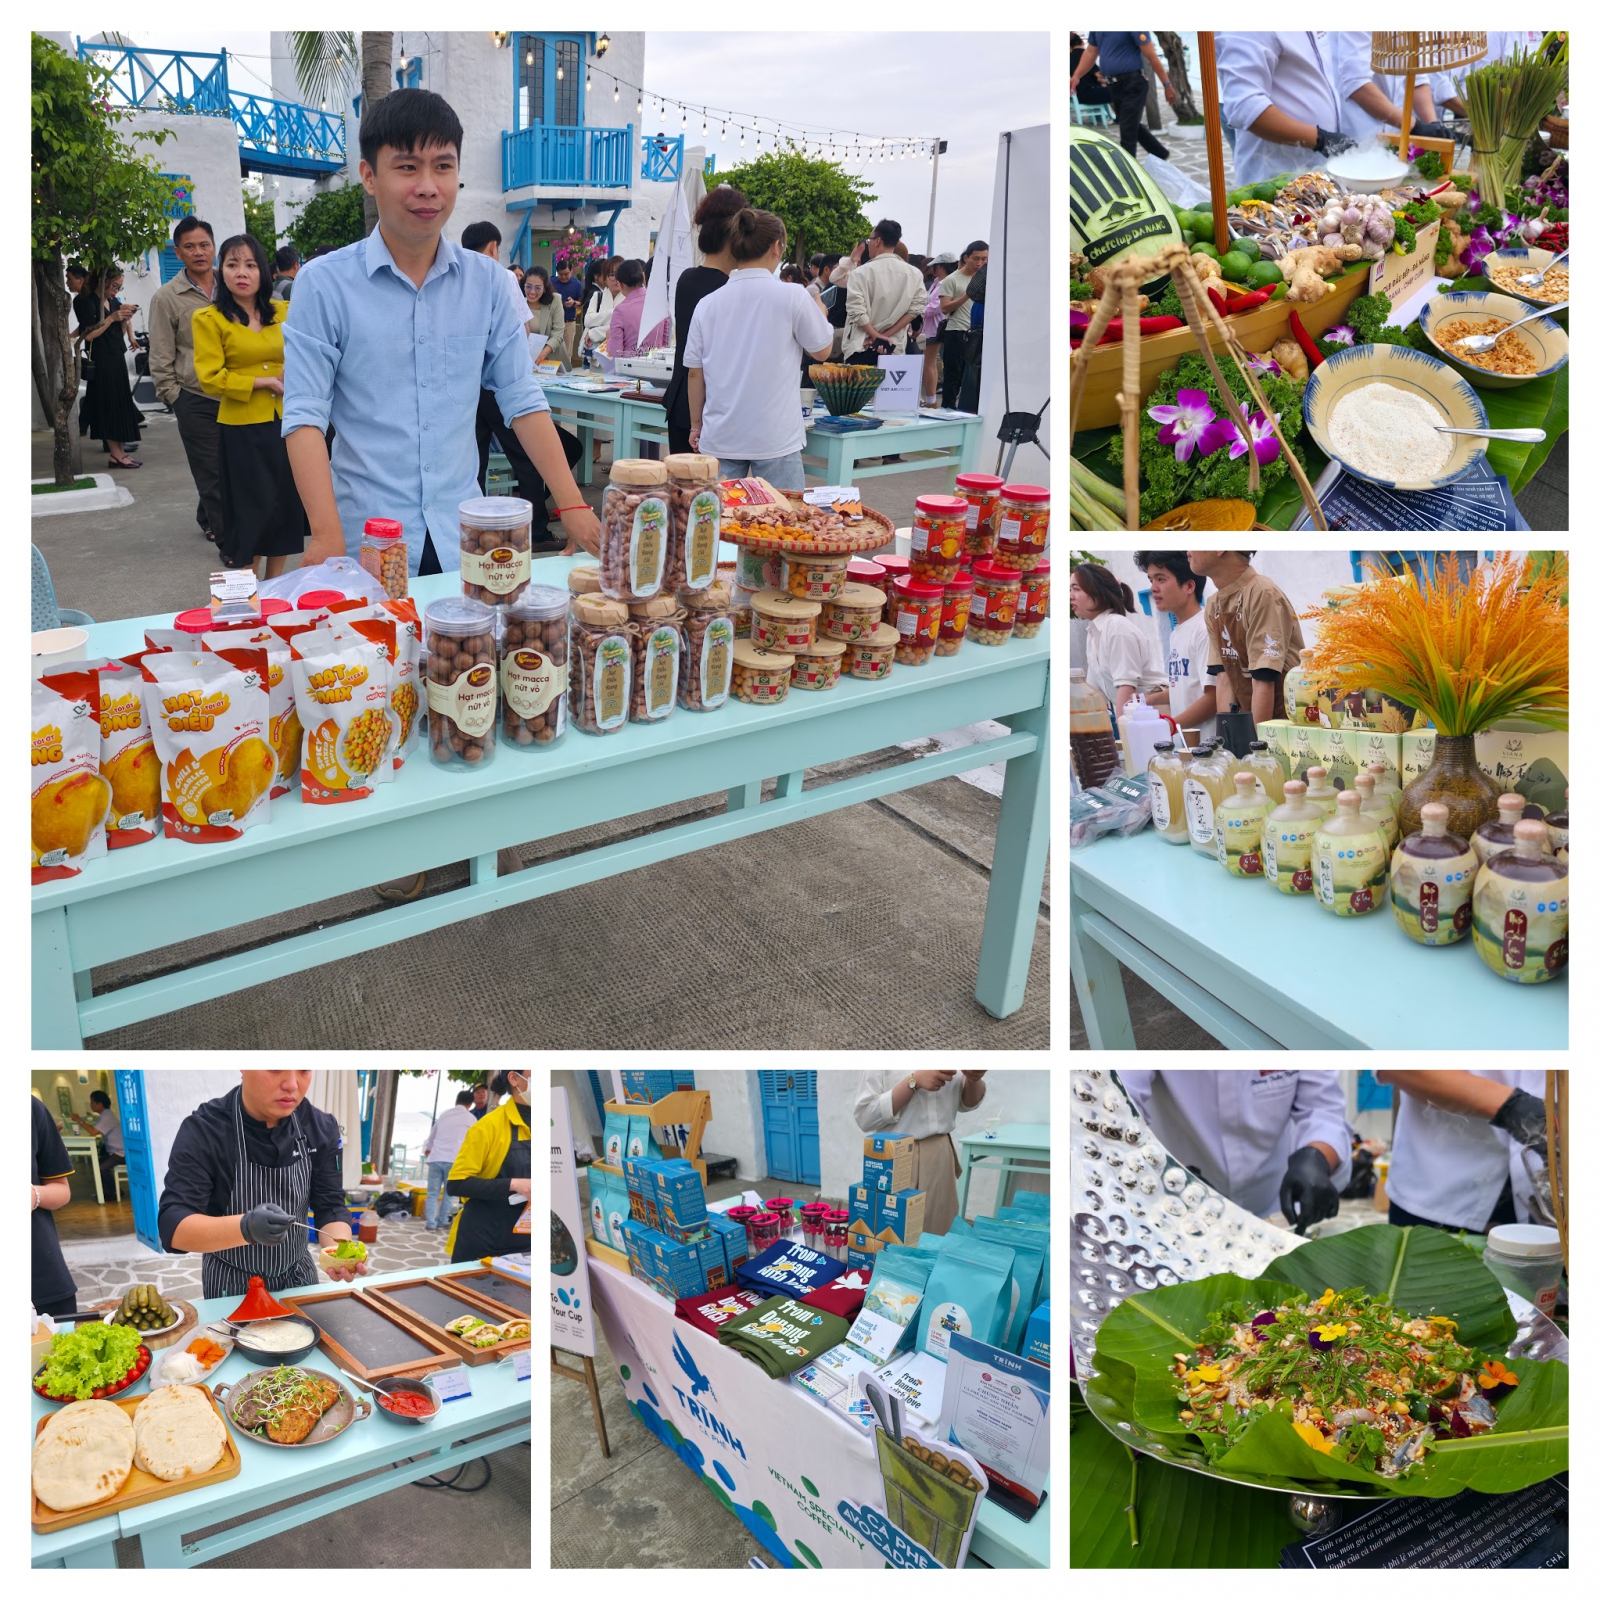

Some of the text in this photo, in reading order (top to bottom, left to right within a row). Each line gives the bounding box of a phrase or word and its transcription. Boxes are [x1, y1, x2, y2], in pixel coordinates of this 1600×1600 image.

[1132, 228, 1145, 239] DA
[478, 560, 523, 571] Hạt macca
[505, 570, 516, 580] vỏ
[308, 664, 346, 690] HẠT
[507, 670, 550, 684] Hạt macca
[316, 686, 353, 705] MIX
[458, 686, 495, 704] Hạt macca
[530, 684, 540, 693] vỏ
[162, 690, 204, 714] HẠT
[483, 698, 491, 708] vỏ
[100, 712, 142, 738] ỘNG
[168, 707, 214, 732] ĐIỀU
[315, 738, 325, 770] SPICY
[175, 760, 200, 790] CHILI &
[181, 769, 206, 795] GARLIC
[187, 776, 210, 799] COATED
[788, 1244, 819, 1262] from
[758, 1266, 786, 1282] with
[784, 1277, 812, 1294] love
[551, 1293, 558, 1303] To
[552, 1306, 582, 1324] Your Cup
[778, 1300, 815, 1322] from
[738, 1324, 774, 1340] with
[759, 1310, 812, 1346] Danang
[772, 1335, 800, 1356] love
[904, 1396, 922, 1410] love
[768, 1466, 865, 1551] VIETNAM SPECIALTY
[796, 1501, 833, 1535] COFFEE
[1318, 1541, 1334, 1553] Sinh
[1344, 1531, 1352, 1540] từ
[1352, 1524, 1368, 1536] sông
[1368, 1516, 1382, 1528] nước
[1384, 1507, 1400, 1520] Nam
[1324, 1514, 1410, 1562] lớn, món gỏi cá trích mang
[1450, 1548, 1464, 1562] bình
[1464, 1544, 1471, 1554] dị
[1471, 1538, 1484, 1550] của
[1484, 1532, 1494, 1544] ngư
[1517, 1511, 1524, 1519] cá
[1524, 1502, 1538, 1514] trích
[1538, 1494, 1551, 1506] Nam
[1480, 1548, 1496, 1560] trong
[1496, 1538, 1510, 1551] từng
[1510, 1528, 1524, 1540] cuốn
[1524, 1516, 1538, 1530] bánh
[867, 1513, 928, 1568] CÀ PHÊ
[1347, 1552, 1360, 1564] của
[1361, 1546, 1368, 1556] cá
[1370, 1539, 1383, 1551] tươi
[1384, 1531, 1397, 1544] mới
[1397, 1523, 1414, 1536] đánh
[1418, 1552, 1431, 1564] rau
[1431, 1543, 1446, 1558] rừng
[1446, 1536, 1460, 1549] tươi
[1461, 1529, 1474, 1541] mát,
[1388, 1555, 1400, 1568] phi
[1400, 1552, 1406, 1562] lê
[1501, 1548, 1511, 1559] khi
[1546, 1550, 1566, 1567] CHÀI
